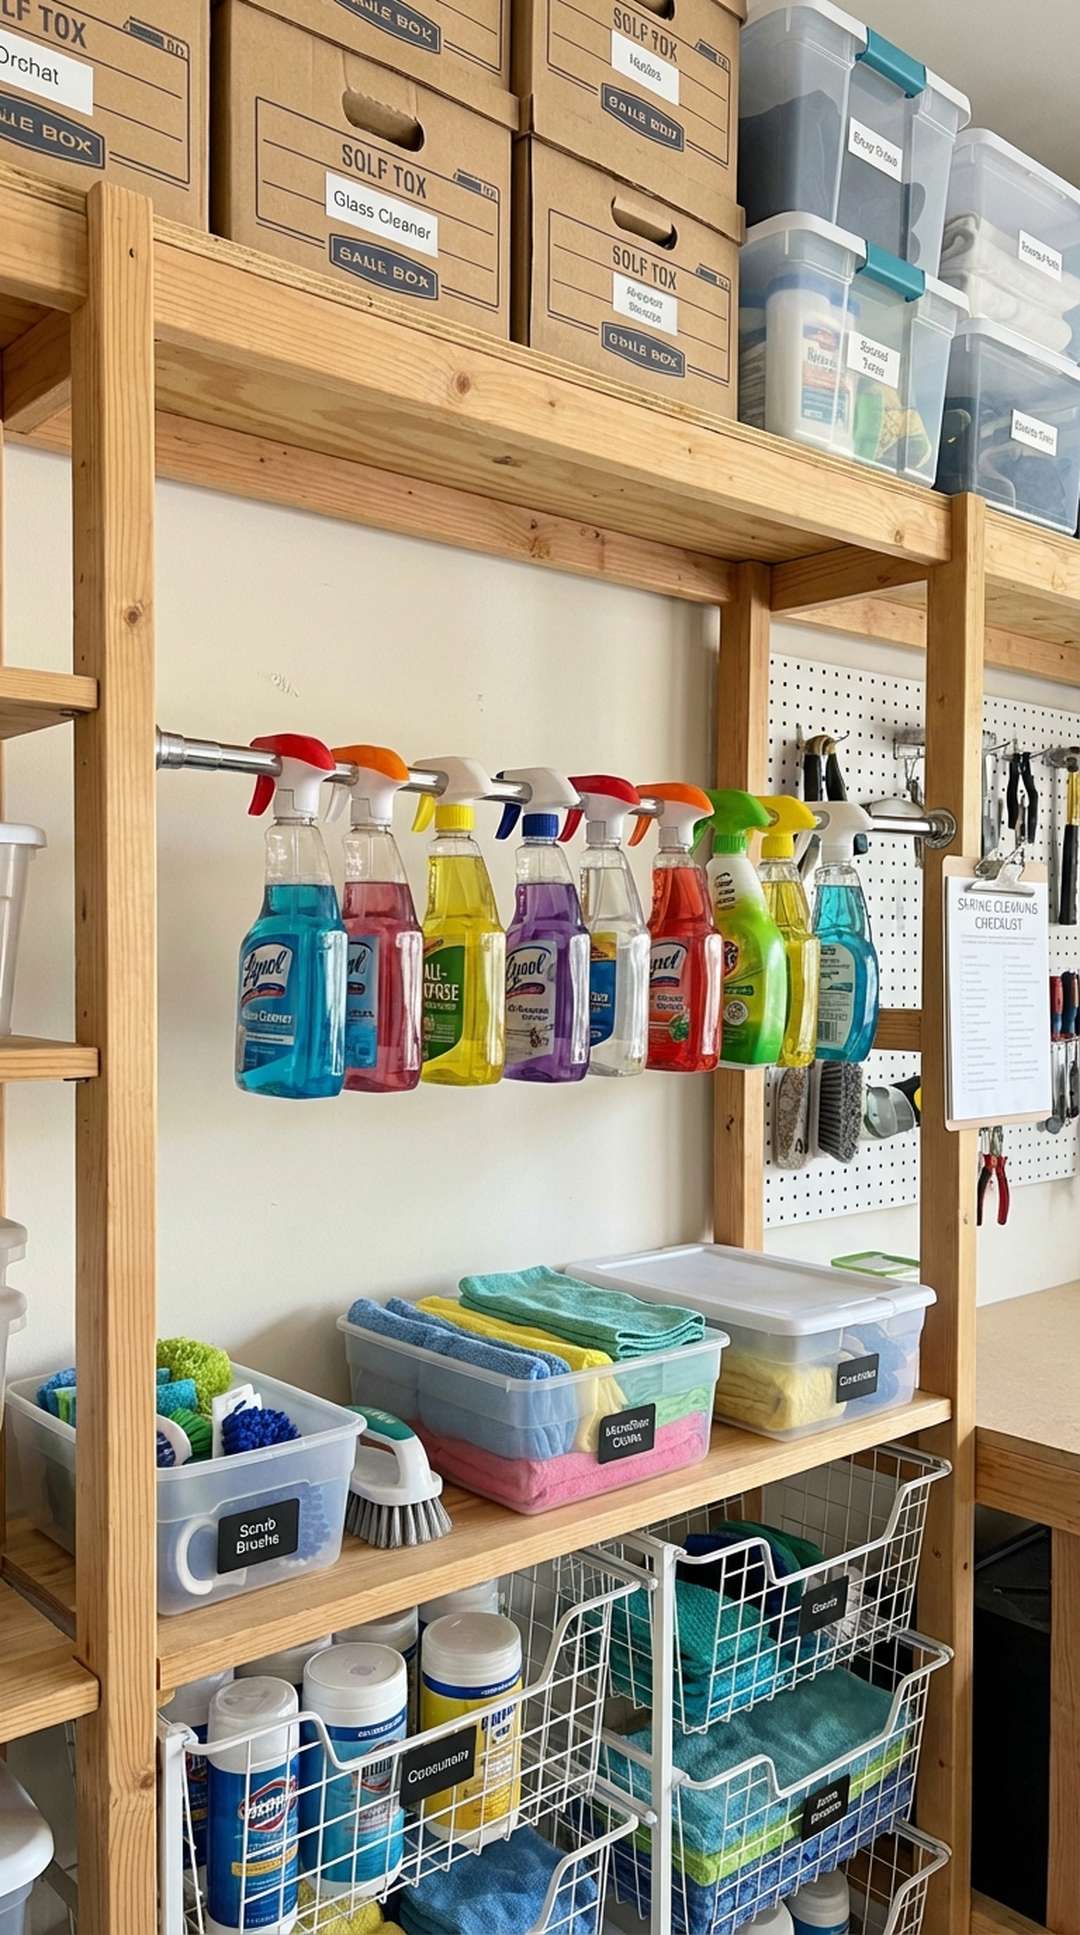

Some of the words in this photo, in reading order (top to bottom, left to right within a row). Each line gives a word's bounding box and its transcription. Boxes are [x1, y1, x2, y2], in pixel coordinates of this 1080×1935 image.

[38, 4, 87, 49] TOX
[42, 124, 93, 156] BOX
[342, 143, 388, 180] SOLF
[393, 164, 426, 199] TOX
[334, 190, 375, 218] Glass
[378, 208, 431, 239] Cleaner
[613, 245, 648, 277] SOLF
[651, 262, 676, 290] TOX
